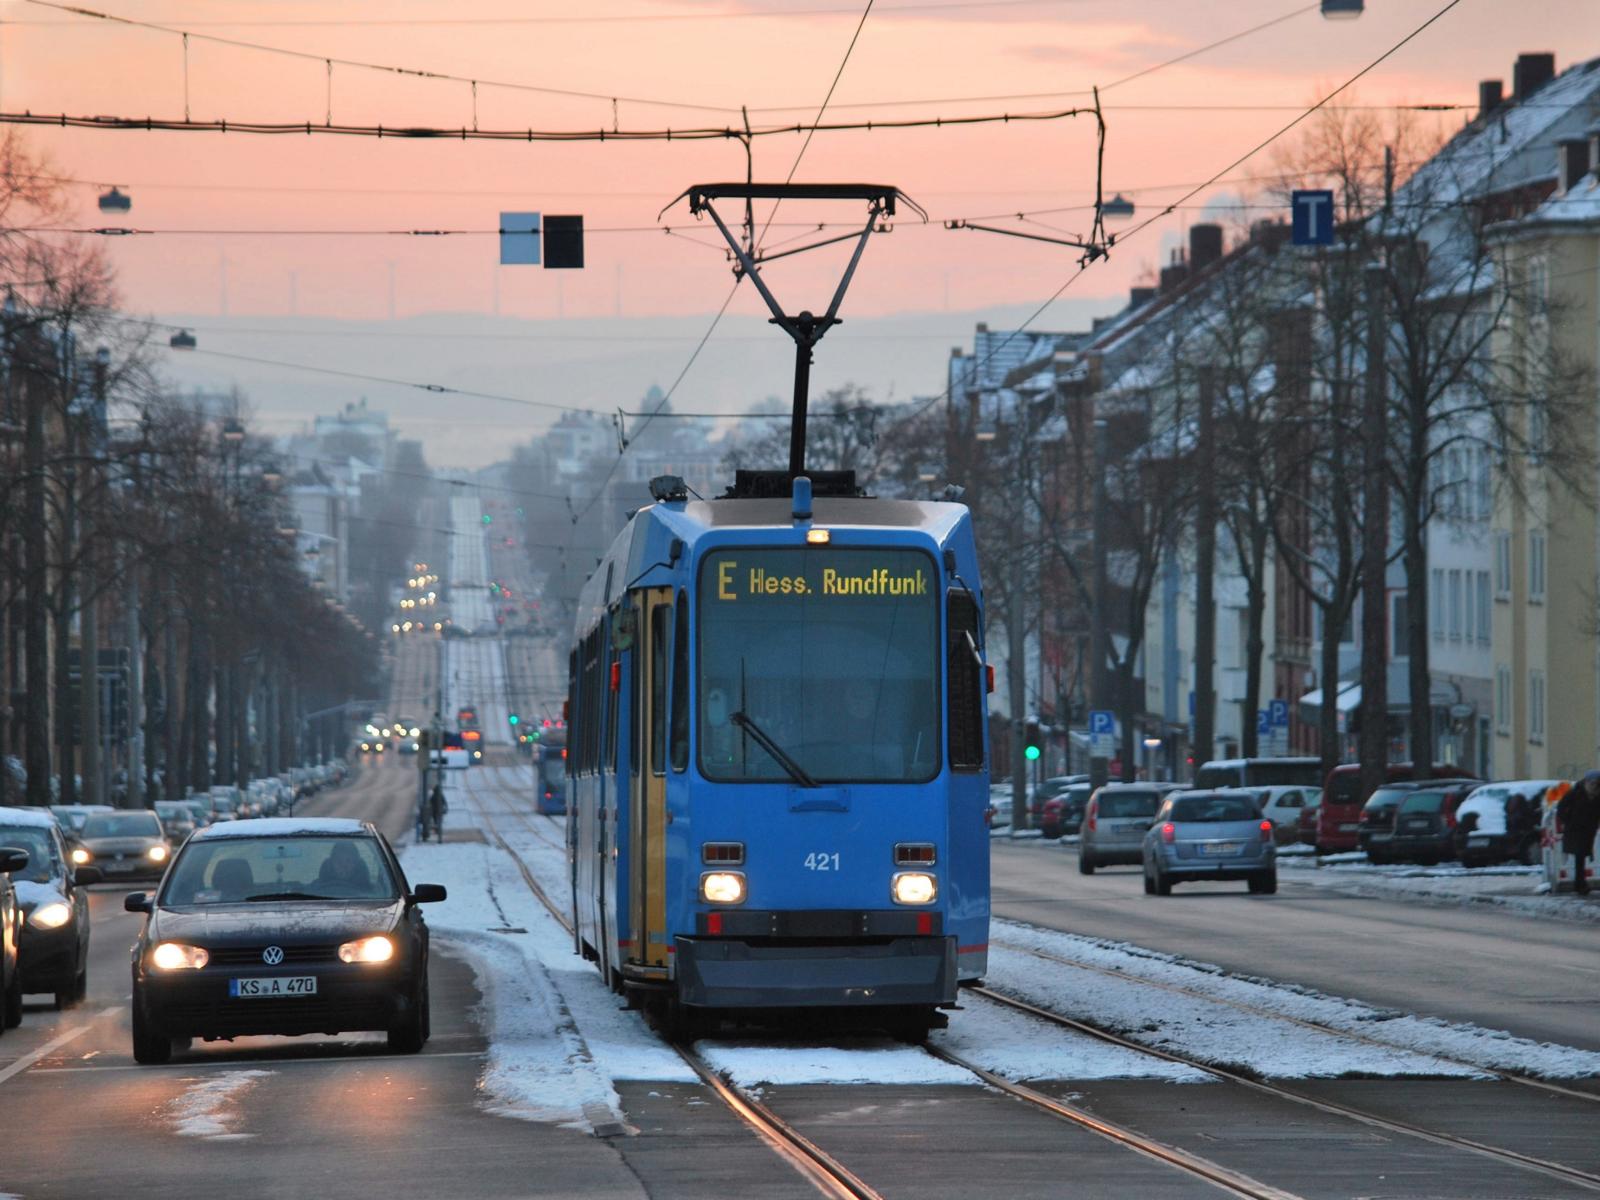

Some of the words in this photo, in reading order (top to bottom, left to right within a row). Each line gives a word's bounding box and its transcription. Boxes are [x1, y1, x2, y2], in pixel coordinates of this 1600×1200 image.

[1299, 196, 1328, 238] T
[719, 562, 737, 600] E
[750, 568, 812, 594] Hess.
[823, 569, 927, 595] Rundfunk
[1094, 714, 1109, 732] P
[804, 852, 839, 870] 421
[240, 980, 260, 994] KS
[272, 979, 280, 993] A
[287, 978, 313, 992] 470
